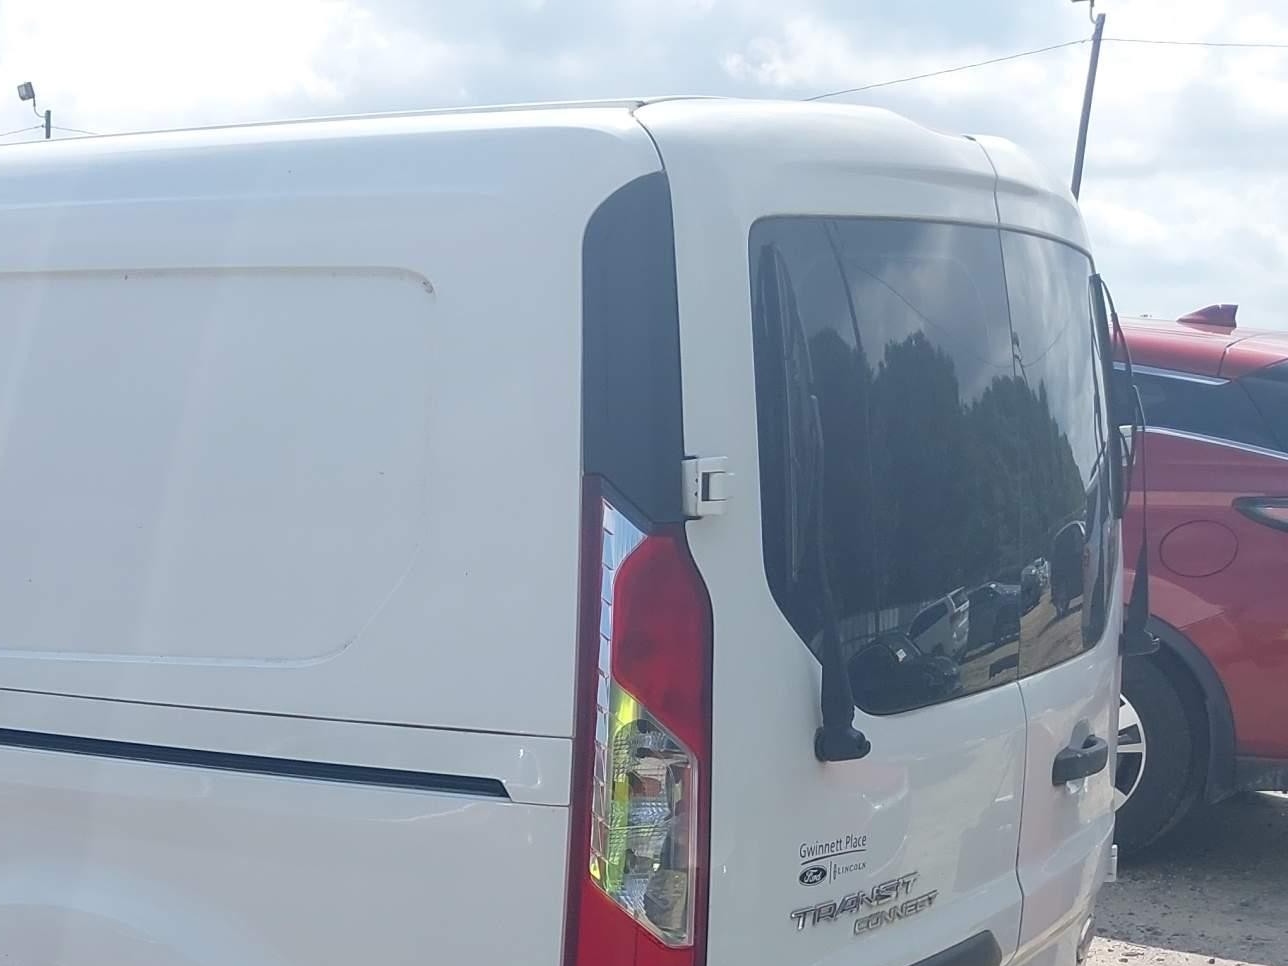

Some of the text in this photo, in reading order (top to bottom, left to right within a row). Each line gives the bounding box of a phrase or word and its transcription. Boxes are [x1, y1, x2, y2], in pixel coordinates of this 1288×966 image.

[799, 834, 867, 859] Gwinnett Place
[802, 868, 824, 883] Ford
[790, 871, 920, 931] TRANSIT
[854, 889, 940, 936] CONNECT
